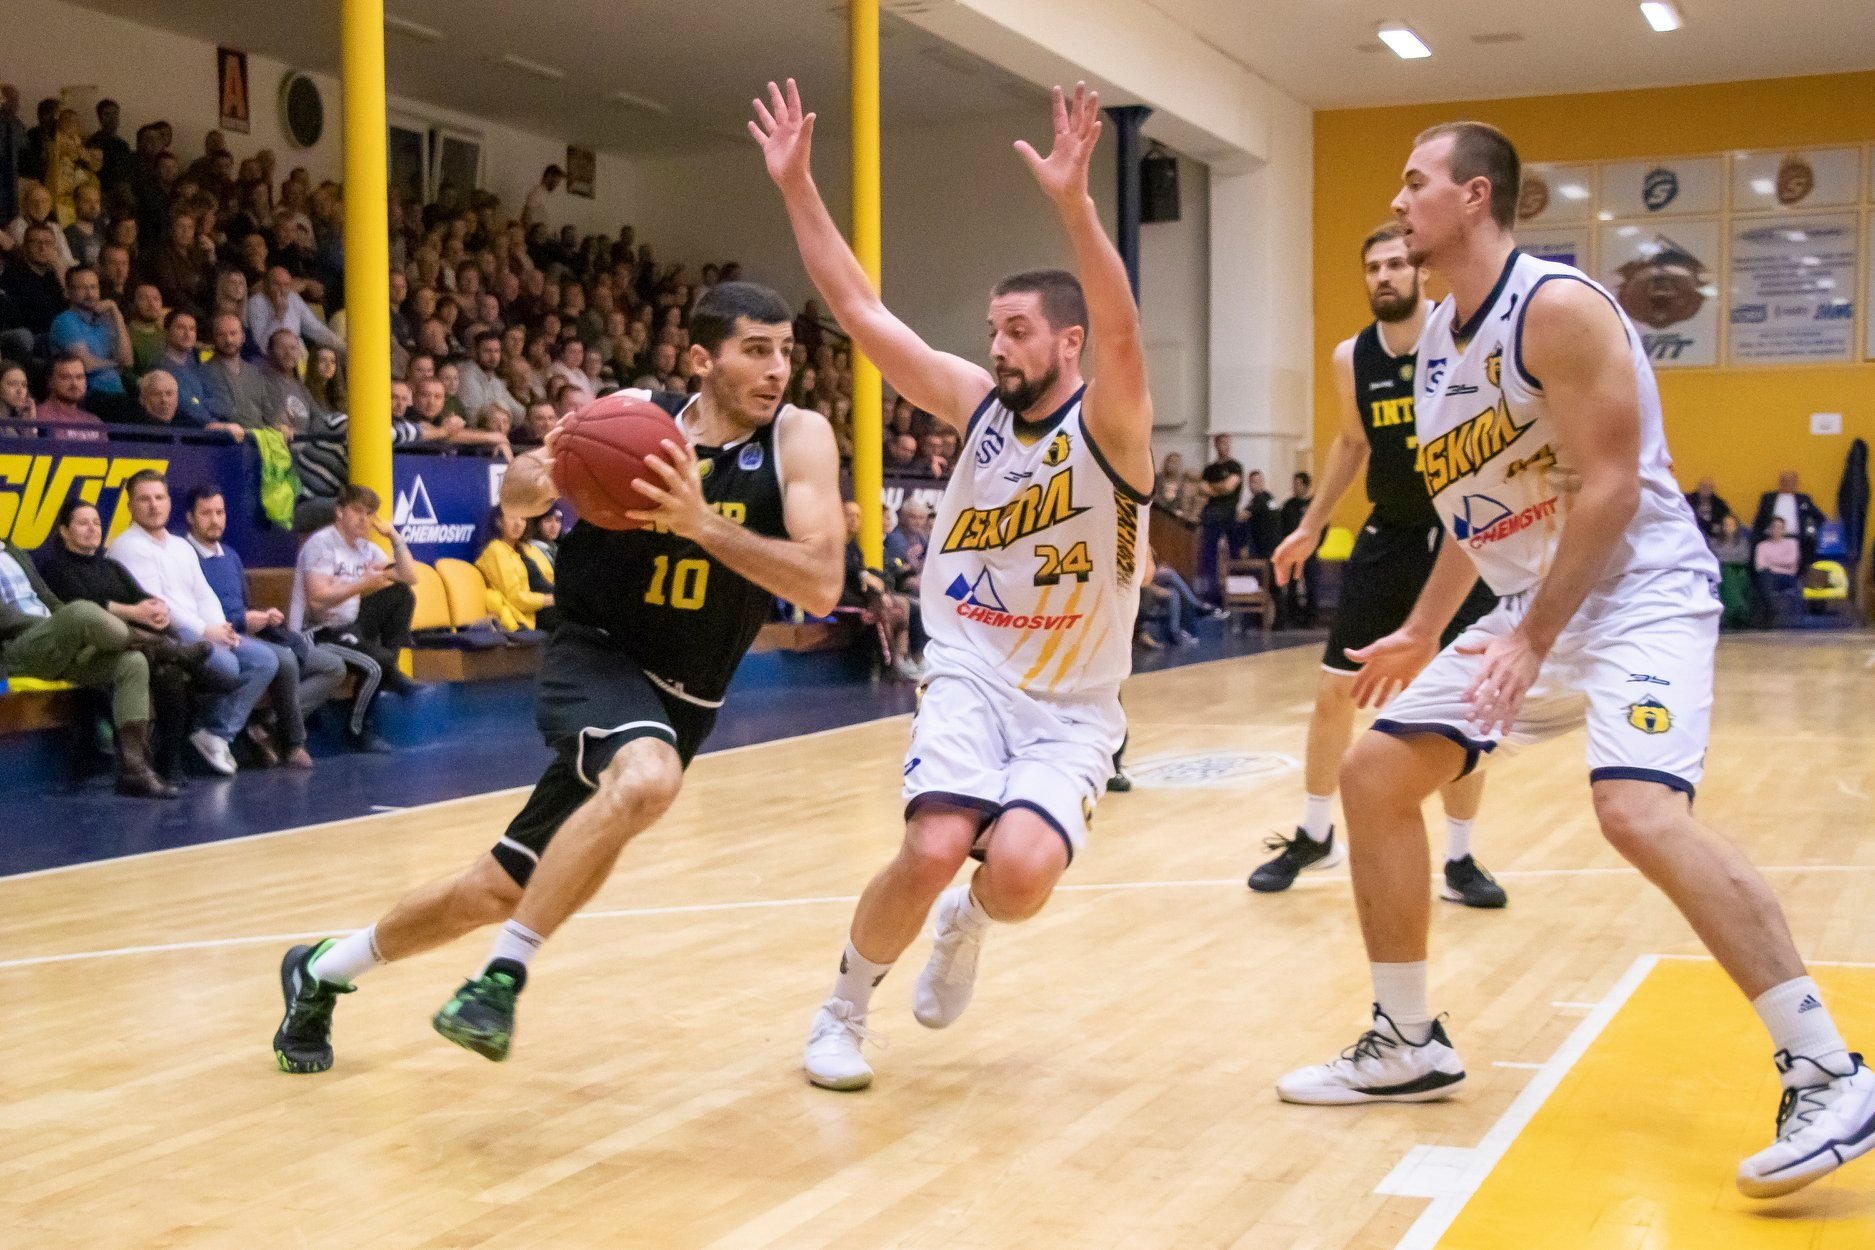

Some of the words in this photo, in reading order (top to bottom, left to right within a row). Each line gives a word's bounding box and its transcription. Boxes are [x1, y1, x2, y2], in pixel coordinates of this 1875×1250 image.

[400, 523, 476, 544] CHEMOSVIT
[939, 466, 1094, 555] ISKRA
[1469, 496, 1558, 549] CHEMSVIT
[644, 554, 710, 611] 10
[1033, 541, 1094, 587] 24
[955, 602, 1084, 631] CHEMOSVIT
